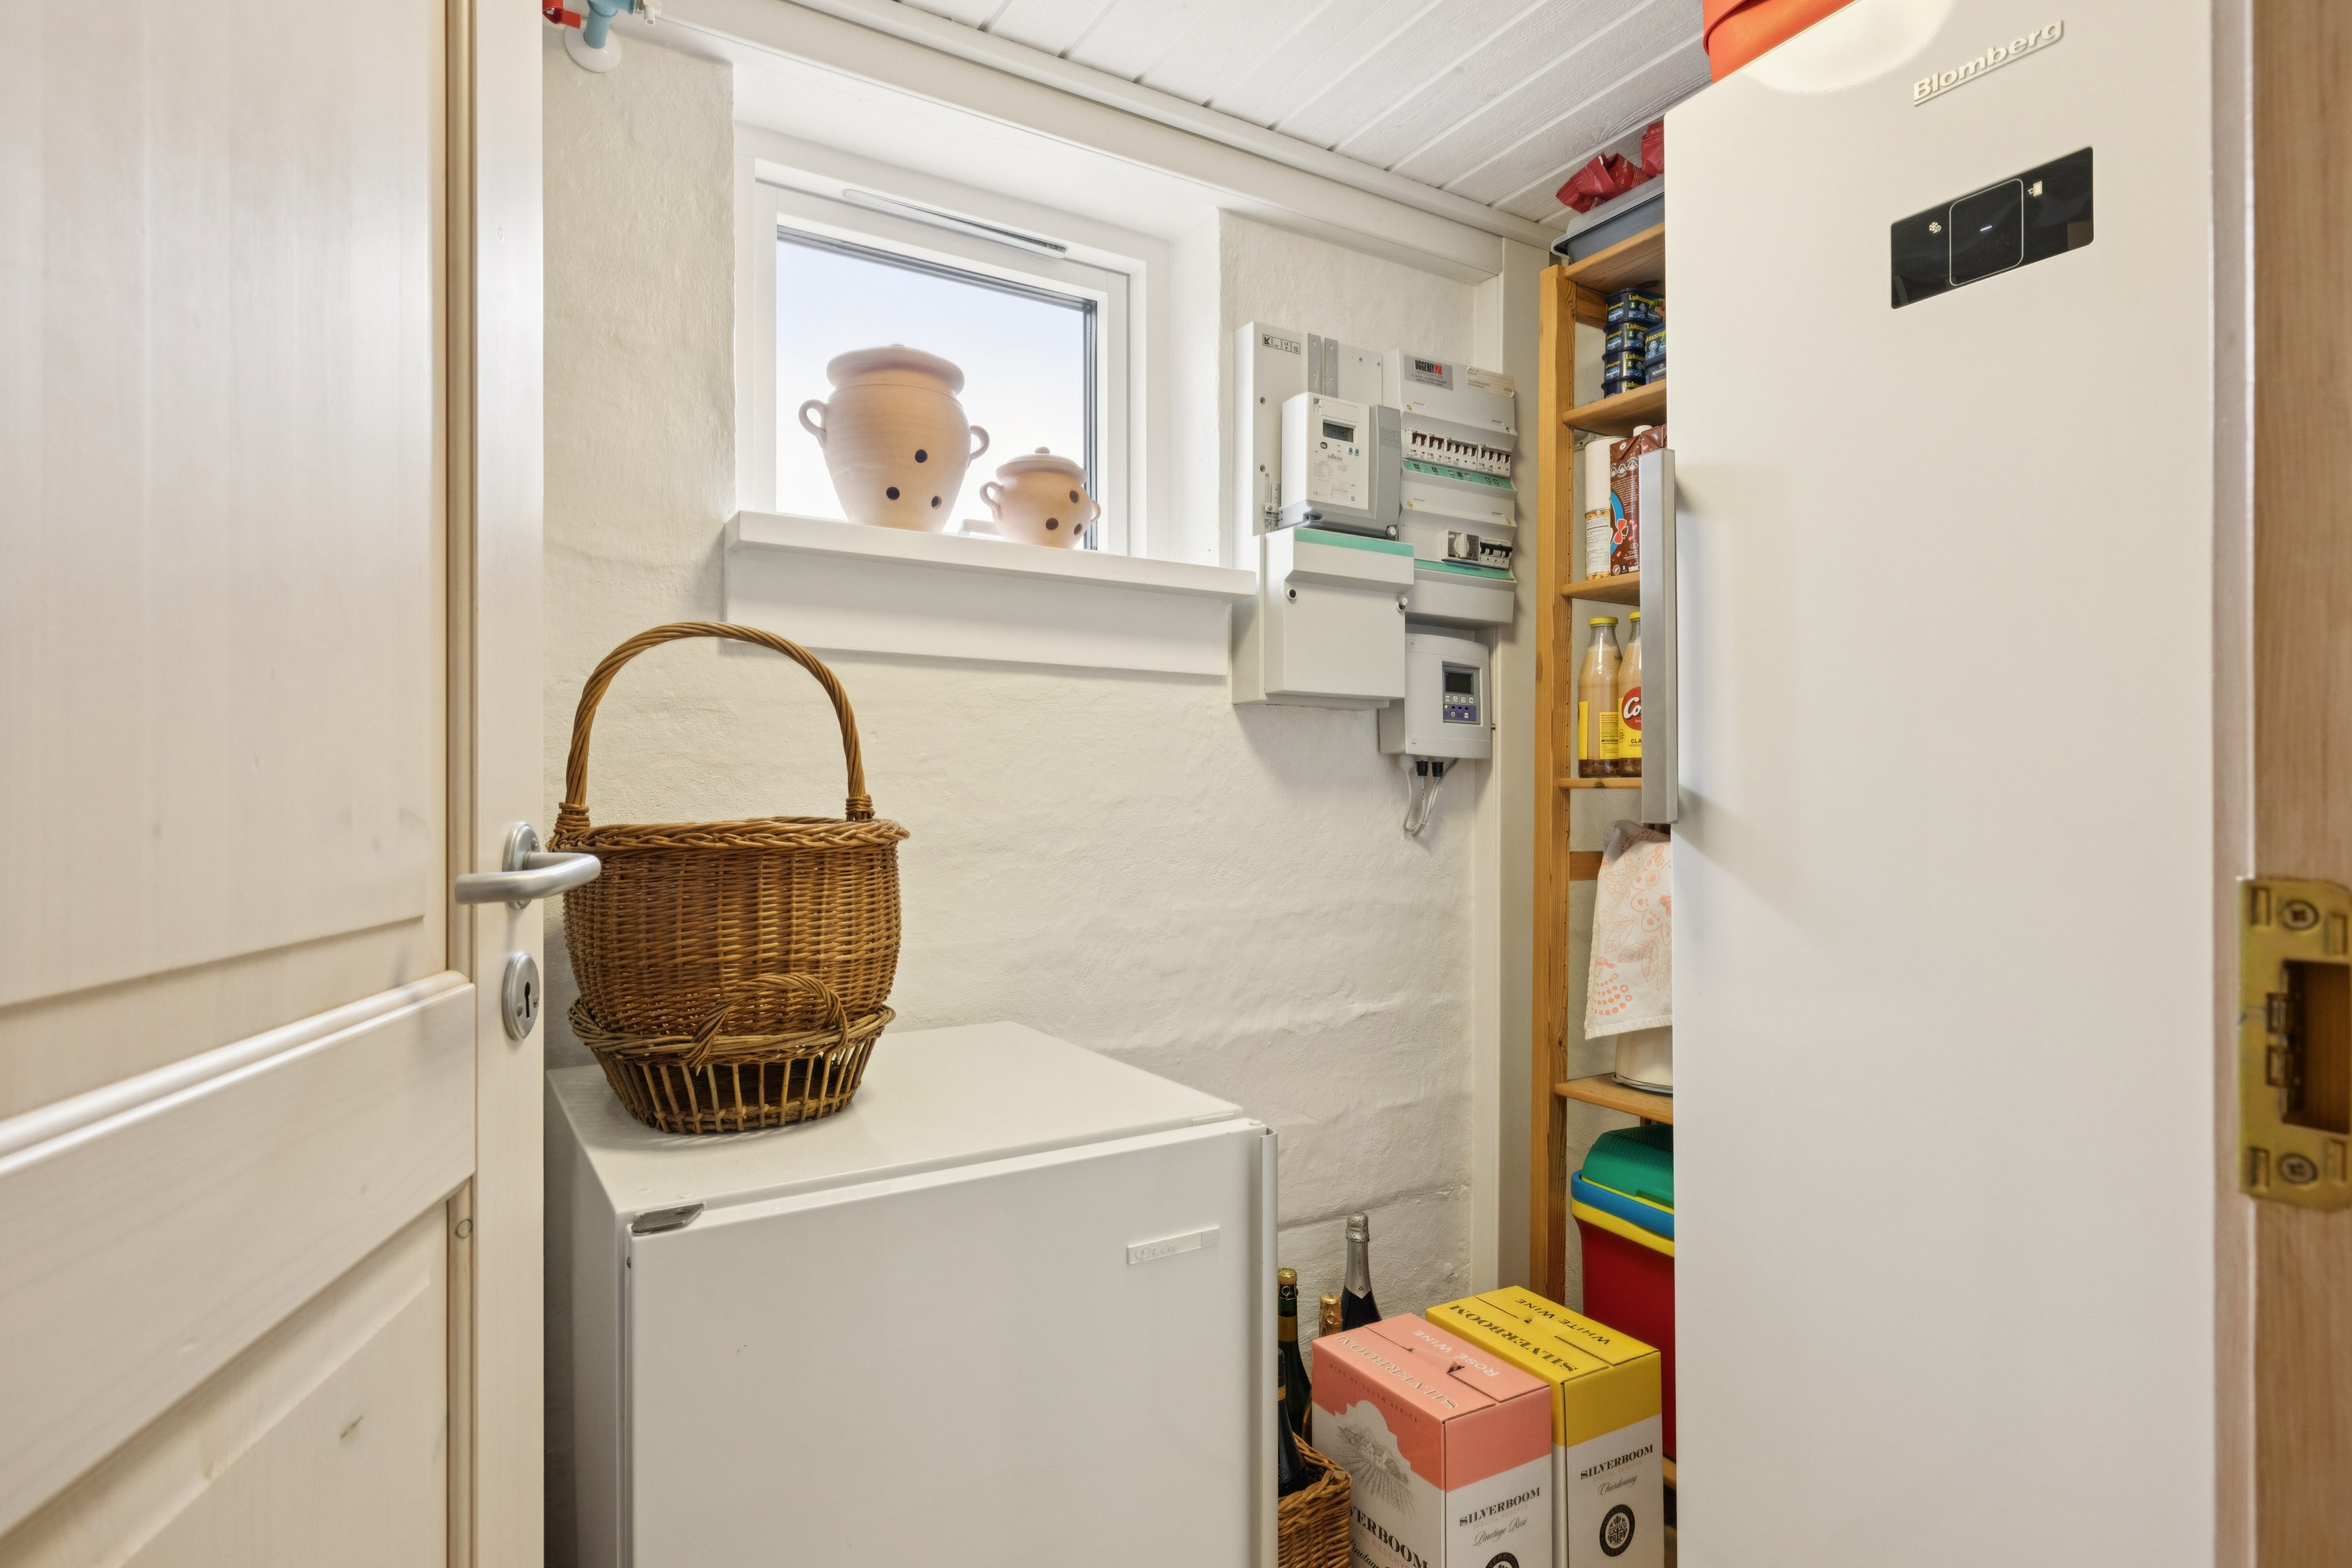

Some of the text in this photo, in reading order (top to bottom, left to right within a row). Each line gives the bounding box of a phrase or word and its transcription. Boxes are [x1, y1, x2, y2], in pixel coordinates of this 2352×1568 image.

[1913, 20, 2064, 105] Blomberg
[1448, 1305, 1578, 1372] SILVERBOOM
[1515, 1298, 1611, 1345] WHITE WINE
[1334, 1336, 1459, 1410] SILVERBOOM
[1412, 1330, 1500, 1377] ROSÉ WINE
[1329, 1363, 1347, 1377] WINE
[1362, 1385, 1386, 1403] SOUTH
[1390, 1403, 1419, 1424] AFRICA
[1581, 1444, 1654, 1480] SILVERBOOM
[1597, 1475, 1639, 1496] Chardonnay
[1459, 1486, 1541, 1527] SILVERBOOM
[1350, 1505, 1428, 1568] VERBOOM
[1472, 1516, 1530, 1547] Pinotage Rosé
